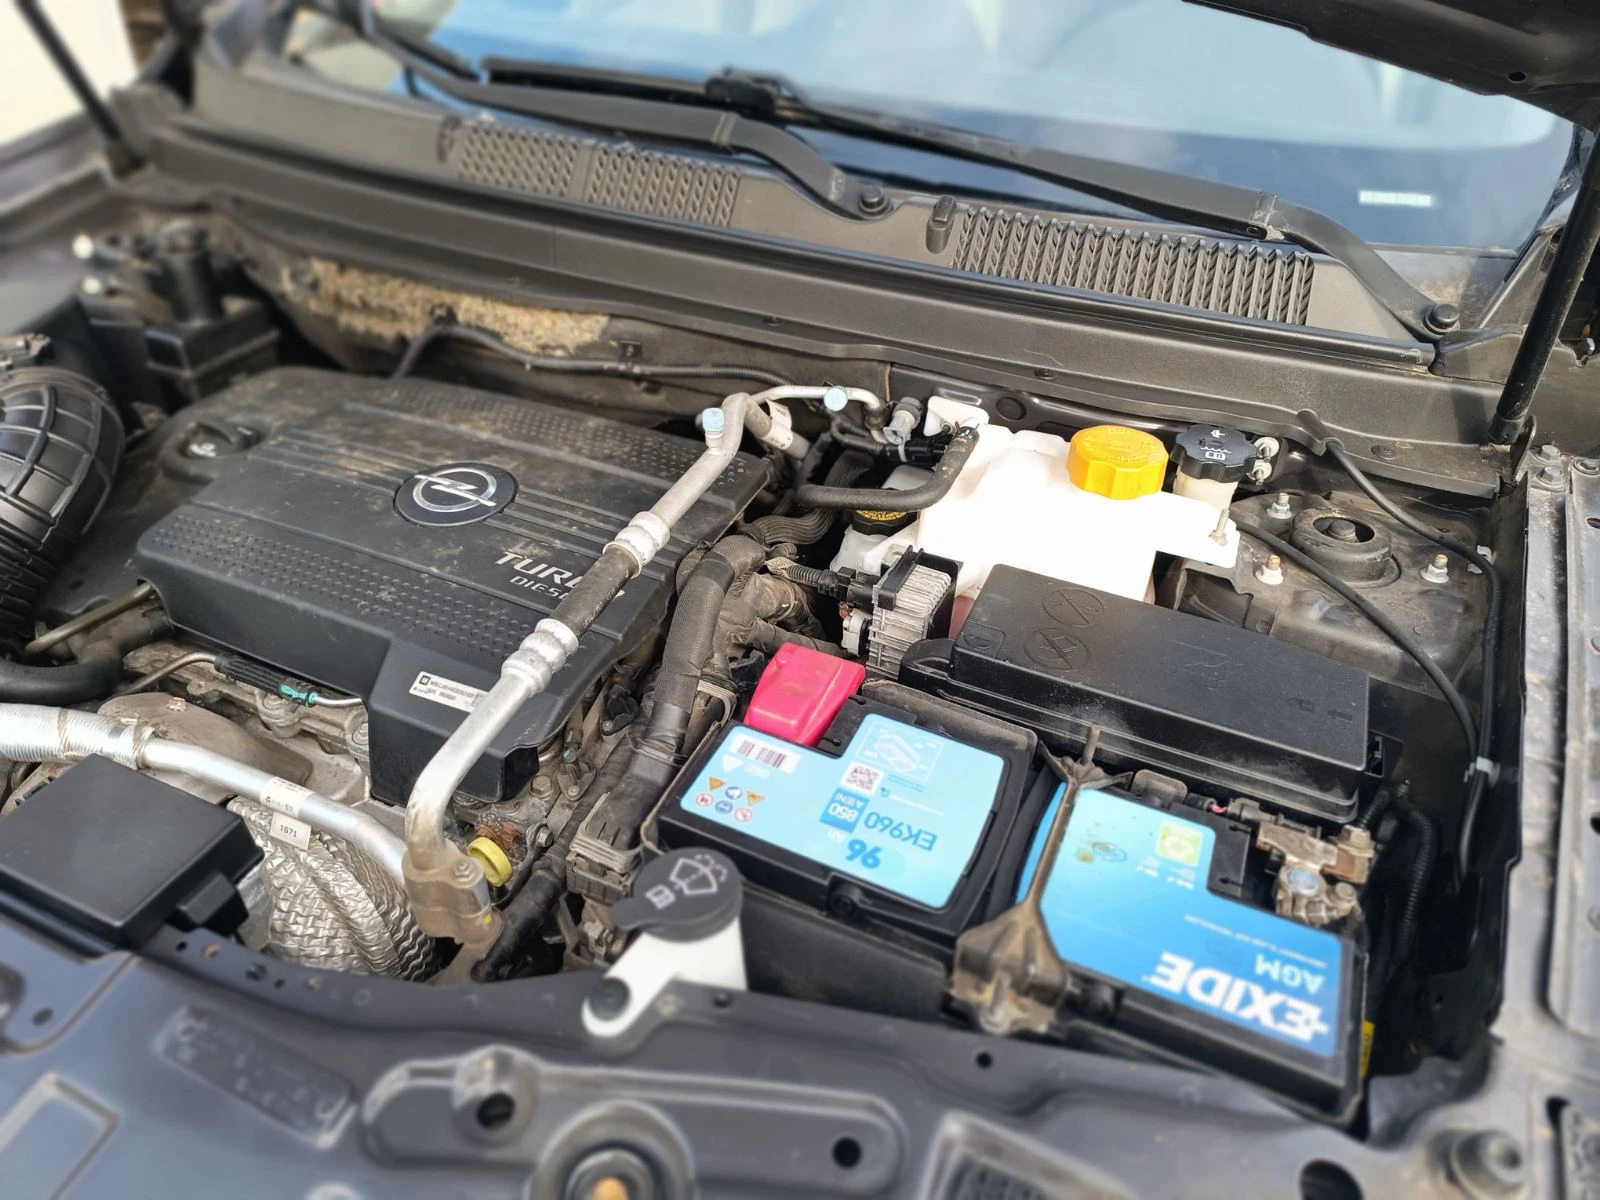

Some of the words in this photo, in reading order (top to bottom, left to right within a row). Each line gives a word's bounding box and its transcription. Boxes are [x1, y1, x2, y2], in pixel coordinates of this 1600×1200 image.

[510, 575, 569, 600] DIES
[827, 802, 858, 822] 850
[863, 811, 938, 851] EK960
[845, 838, 882, 869] 96
[1254, 953, 1324, 995] AGM
[1150, 950, 1326, 1043] EXIDE
